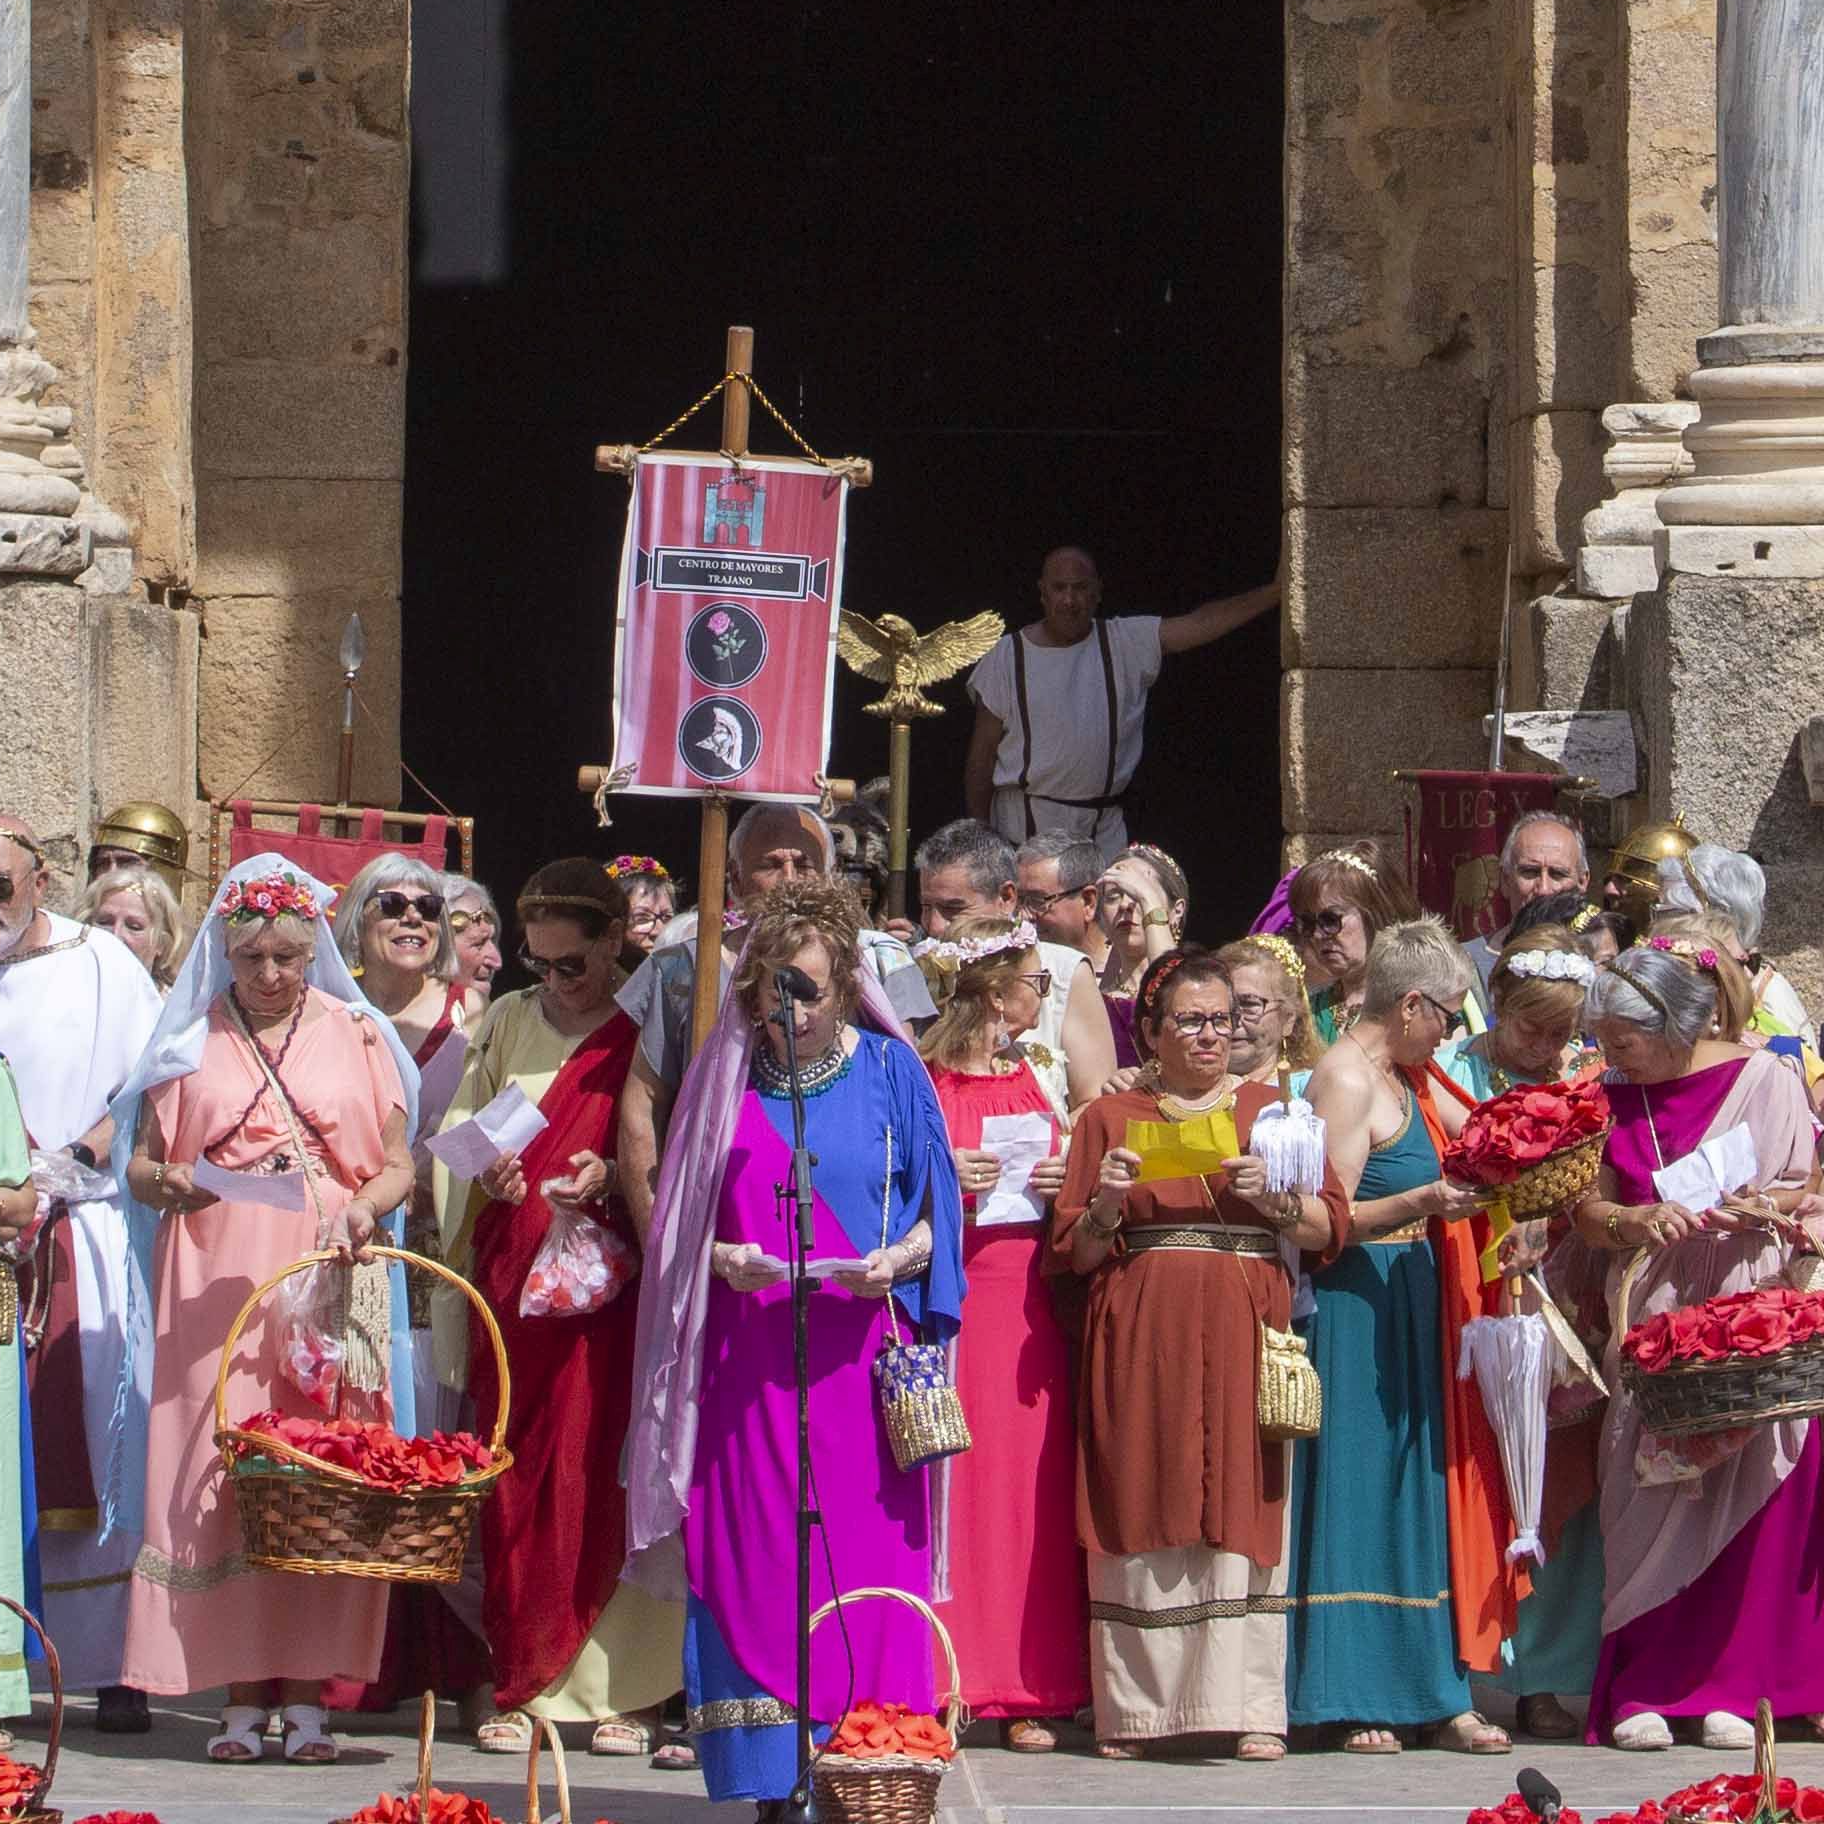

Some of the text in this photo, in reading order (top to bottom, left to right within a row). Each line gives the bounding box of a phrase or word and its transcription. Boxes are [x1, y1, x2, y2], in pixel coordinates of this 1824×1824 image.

[678, 558, 784, 574] CENTRO DE MAYORES
[708, 574, 753, 586] TRAJANO
